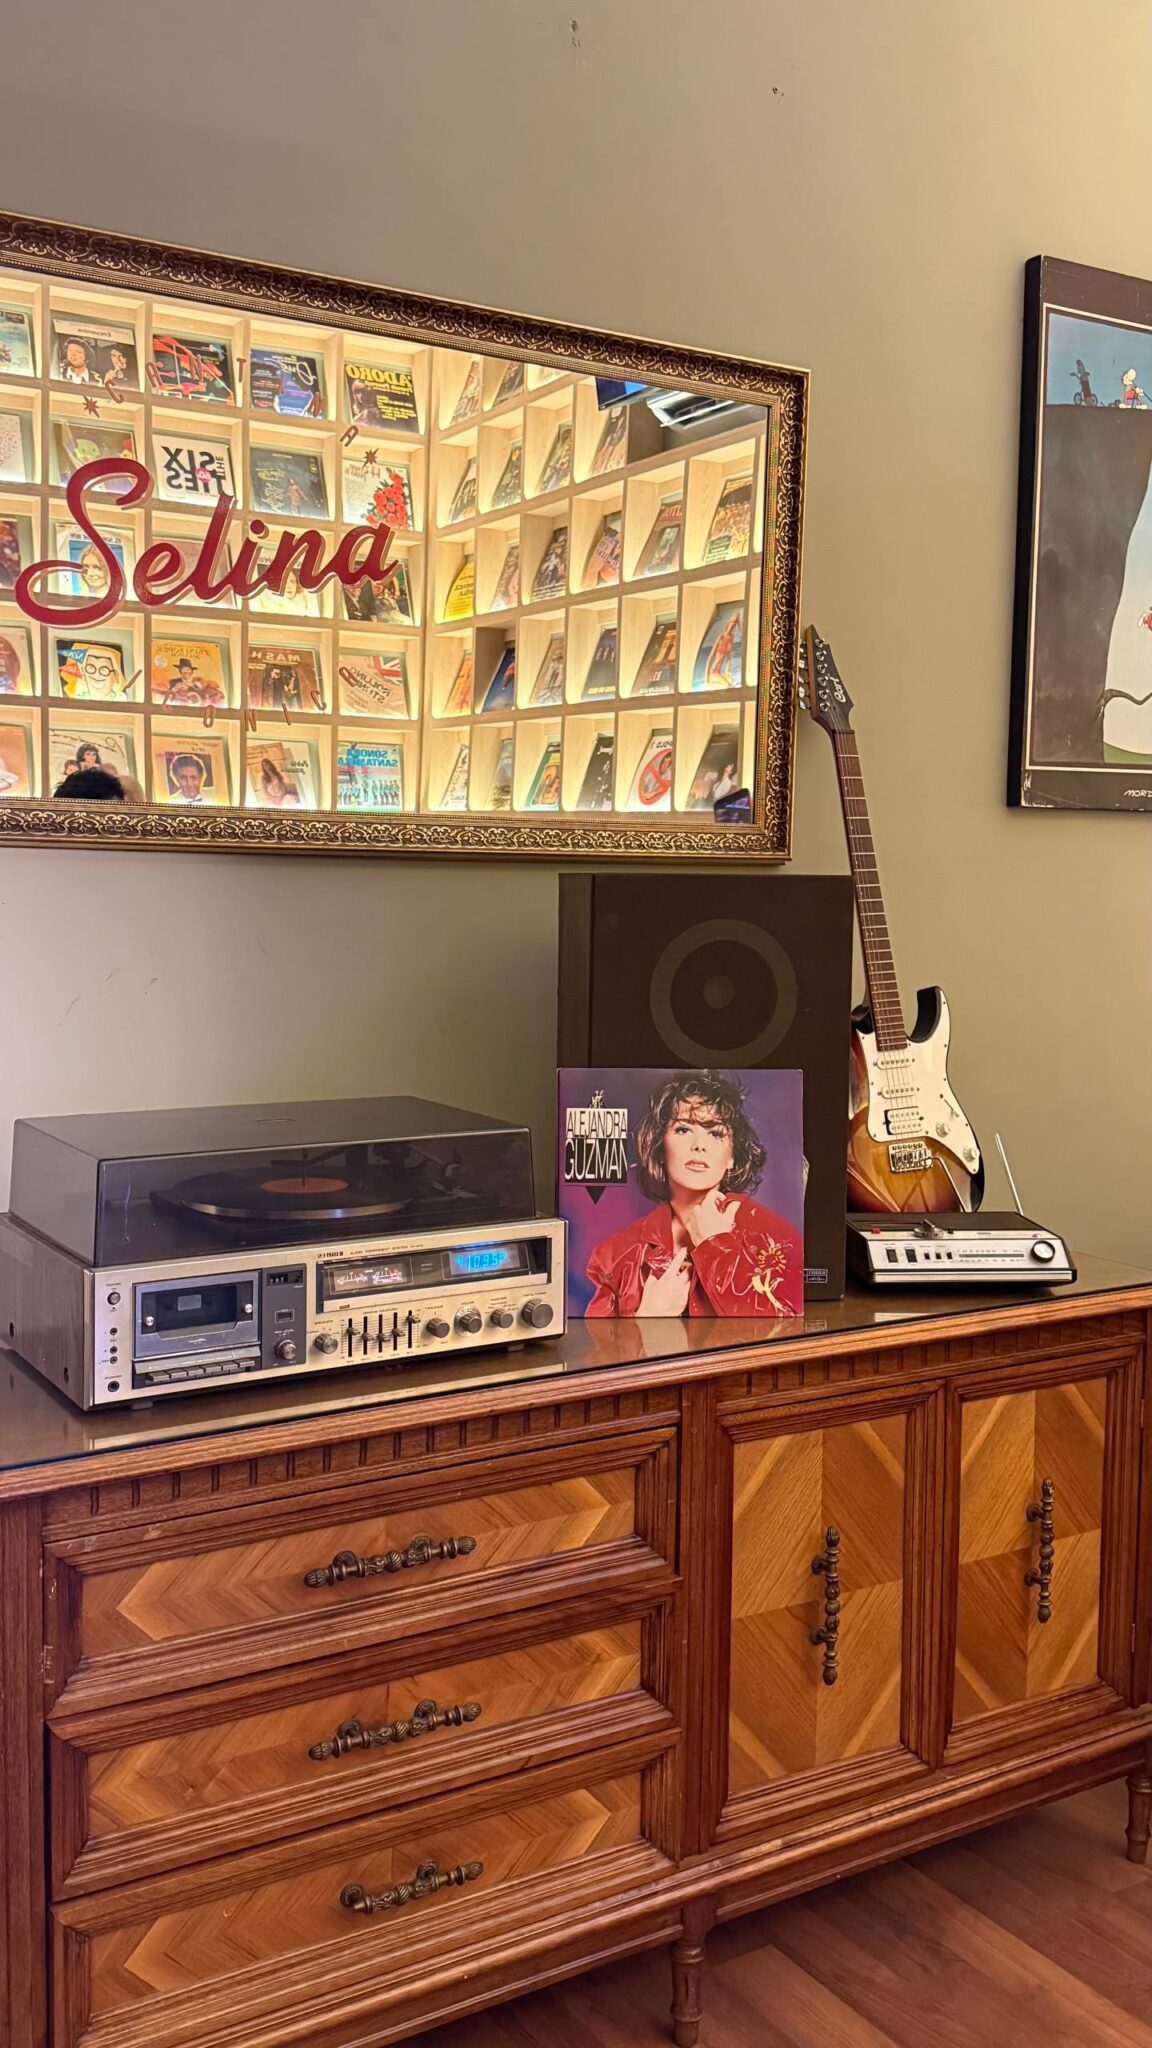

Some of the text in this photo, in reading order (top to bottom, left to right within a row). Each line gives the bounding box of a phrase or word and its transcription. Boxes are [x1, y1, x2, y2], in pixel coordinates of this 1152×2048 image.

[15, 457, 400, 626] Selina
[828, 674, 847, 703] Cort
[566, 1109, 628, 1139] ALEJANDRA
[564, 1138, 628, 1180] GUZMAN
